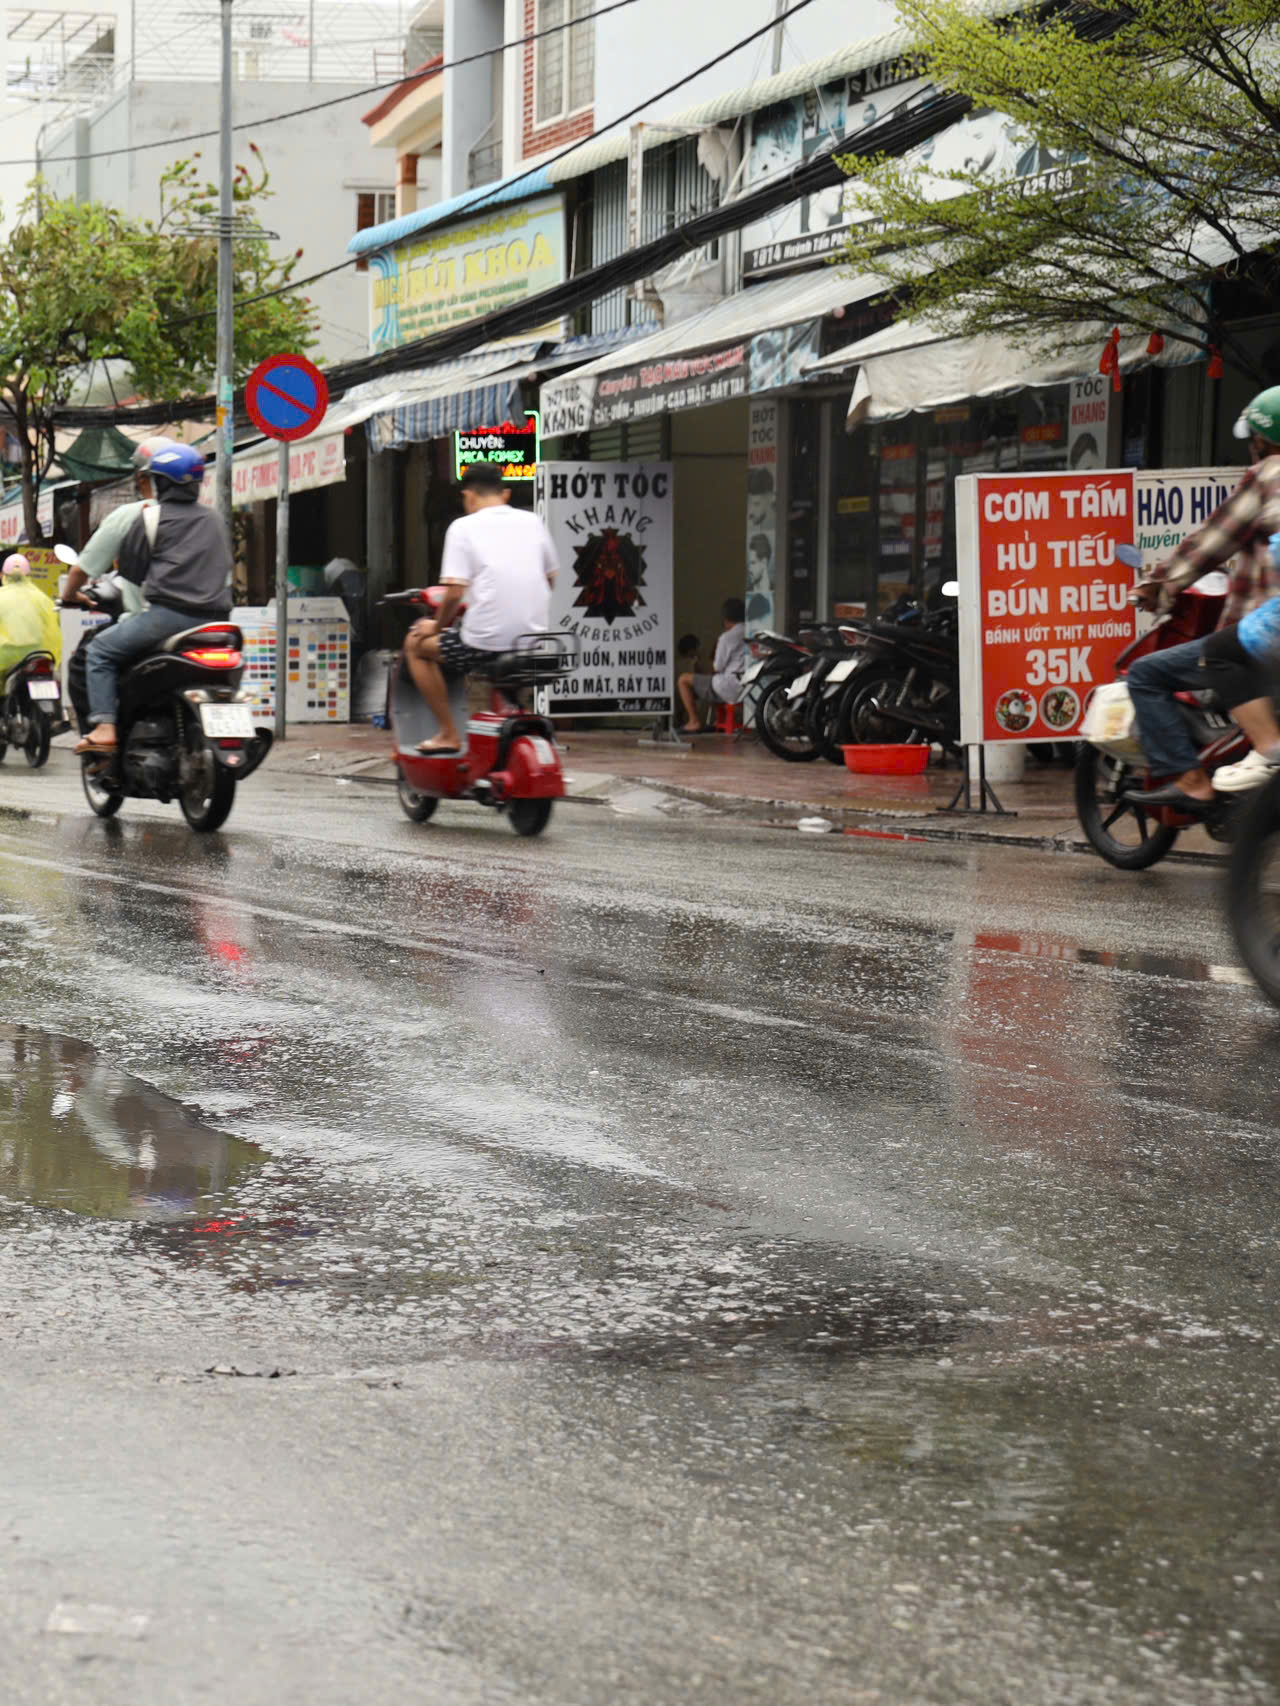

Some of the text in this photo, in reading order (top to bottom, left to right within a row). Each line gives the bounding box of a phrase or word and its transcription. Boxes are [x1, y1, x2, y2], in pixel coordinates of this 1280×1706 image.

[1071, 400, 1106, 425] KHANG
[550, 467, 606, 499] HỚT
[613, 465, 668, 499] TÓC
[984, 480, 1127, 522] CƠM TẤM
[1137, 478, 1184, 526] HÀO
[565, 504, 655, 535] KHANG
[997, 530, 1037, 571] HỦ
[1047, 531, 1116, 568] TIẾU
[987, 579, 1128, 617] BÚN RIÊU
[559, 613, 661, 643] BARBERSHOP
[985, 618, 1131, 645] BÁNH ƯỚT THỊT NƯỚNG
[583, 645, 615, 668] UỐN,
[618, 648, 667, 671] NHUỘM
[1026, 646, 1093, 685] 35K
[553, 673, 666, 698] CẠO MẶT, RÁY TAI
